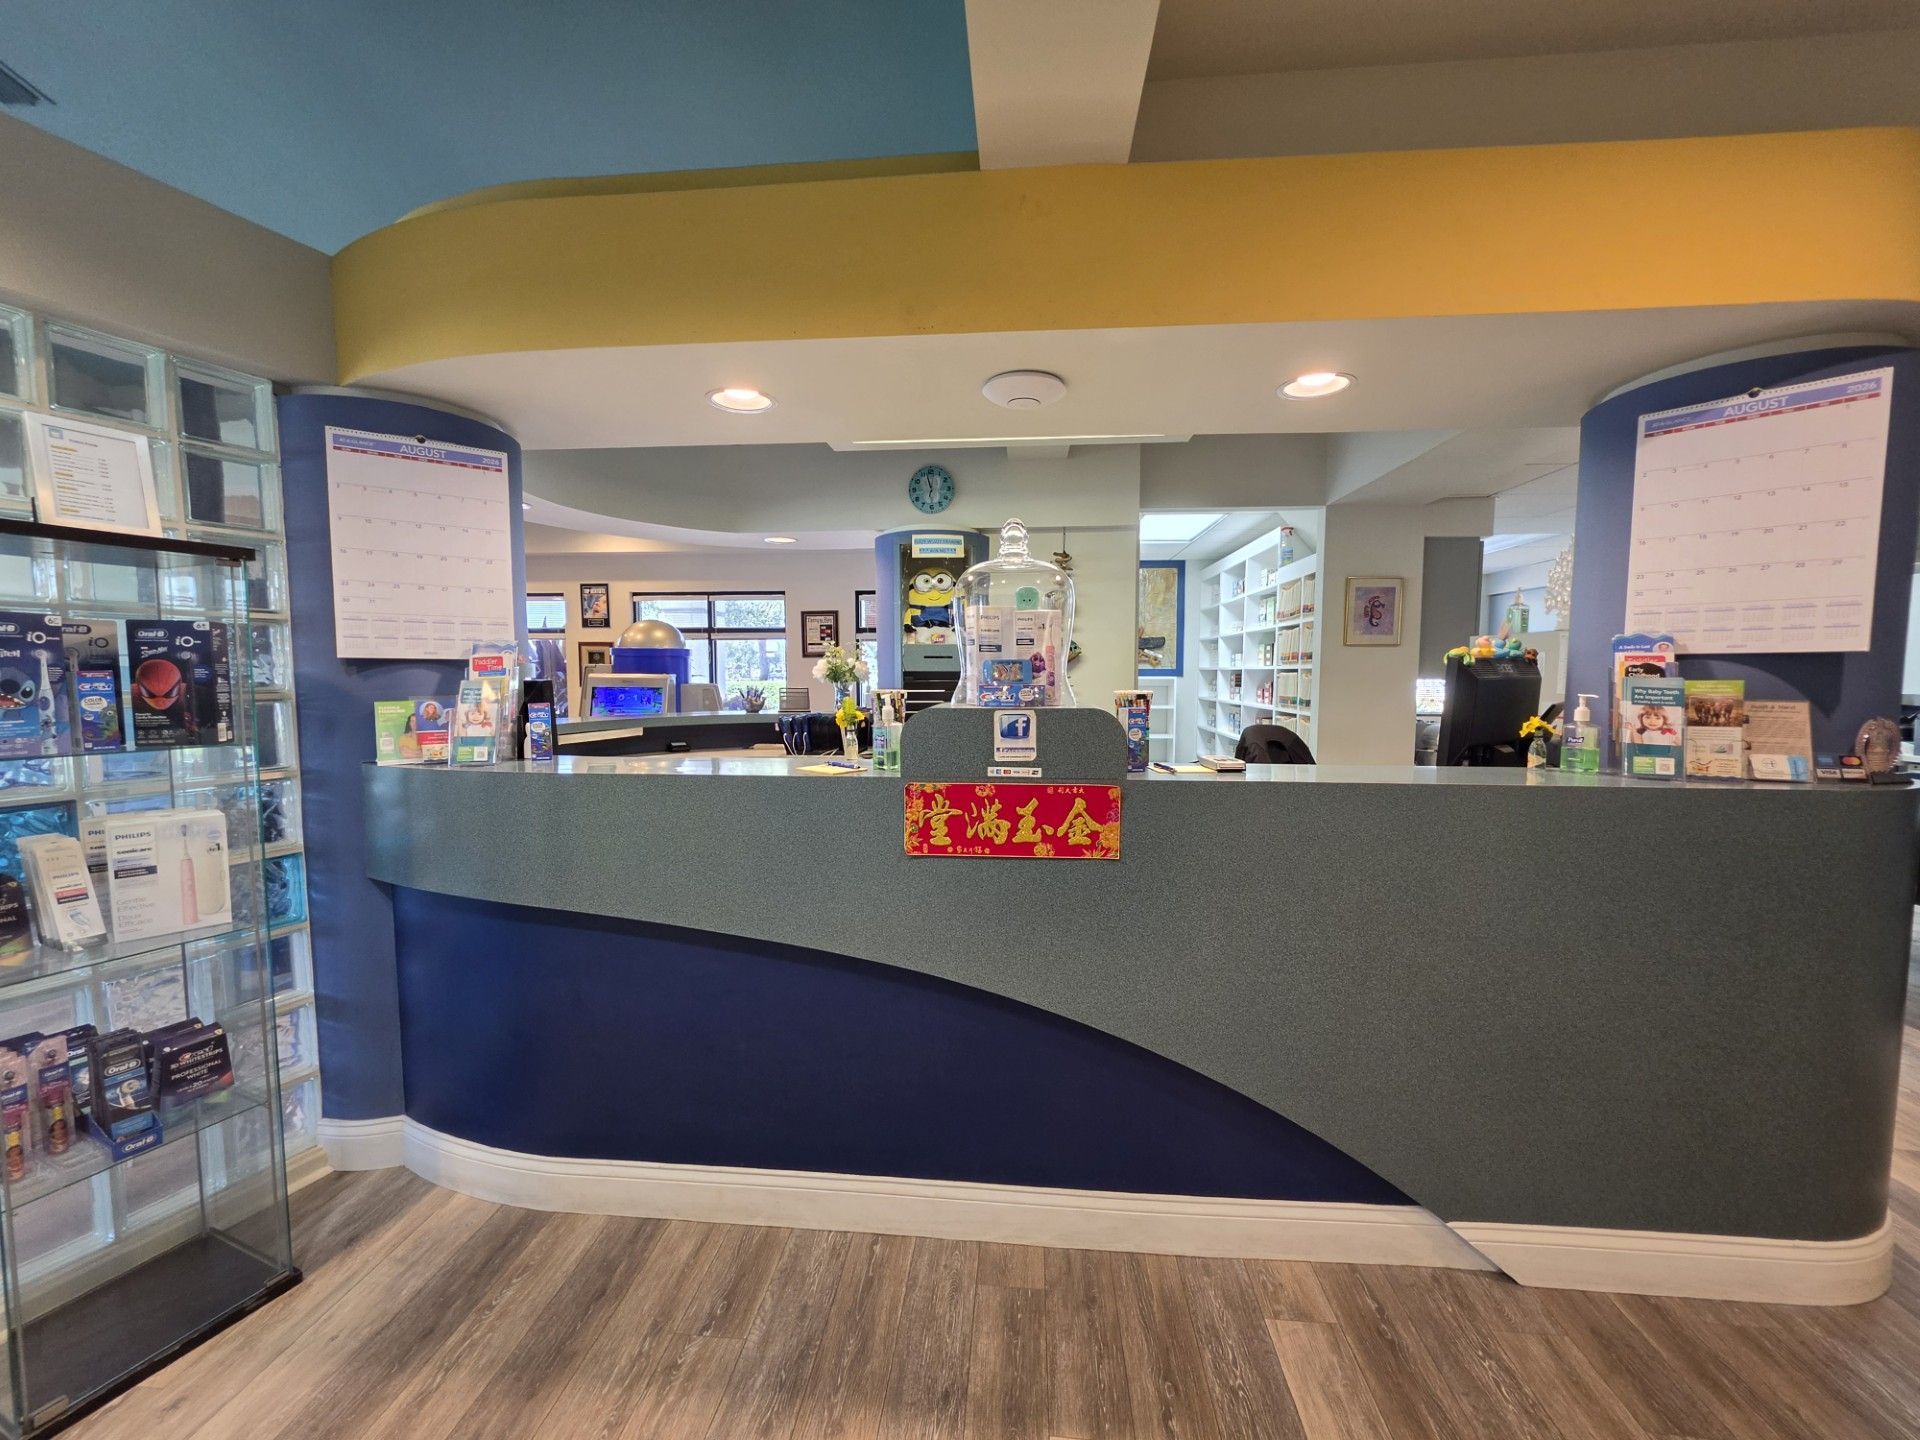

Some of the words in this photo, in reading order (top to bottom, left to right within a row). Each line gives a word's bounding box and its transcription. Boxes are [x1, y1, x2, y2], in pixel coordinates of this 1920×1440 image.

[1723, 396, 1789, 417] AUGUST
[1846, 381, 1877, 394] 2026
[400, 444, 447, 459] AUGUST
[79, 682, 112, 691] Crest
[115, 832, 152, 840] PHILIPS
[116, 847, 152, 855] sonicare
[68, 1047, 88, 1056] Oral
[180, 1048, 224, 1066] WHITESTRIPS
[108, 1061, 137, 1074] Oral-B
[172, 1060, 222, 1080] PROFESSIONAL
[187, 1069, 208, 1080] WHITE
[125, 1136, 154, 1151] Oral-B
